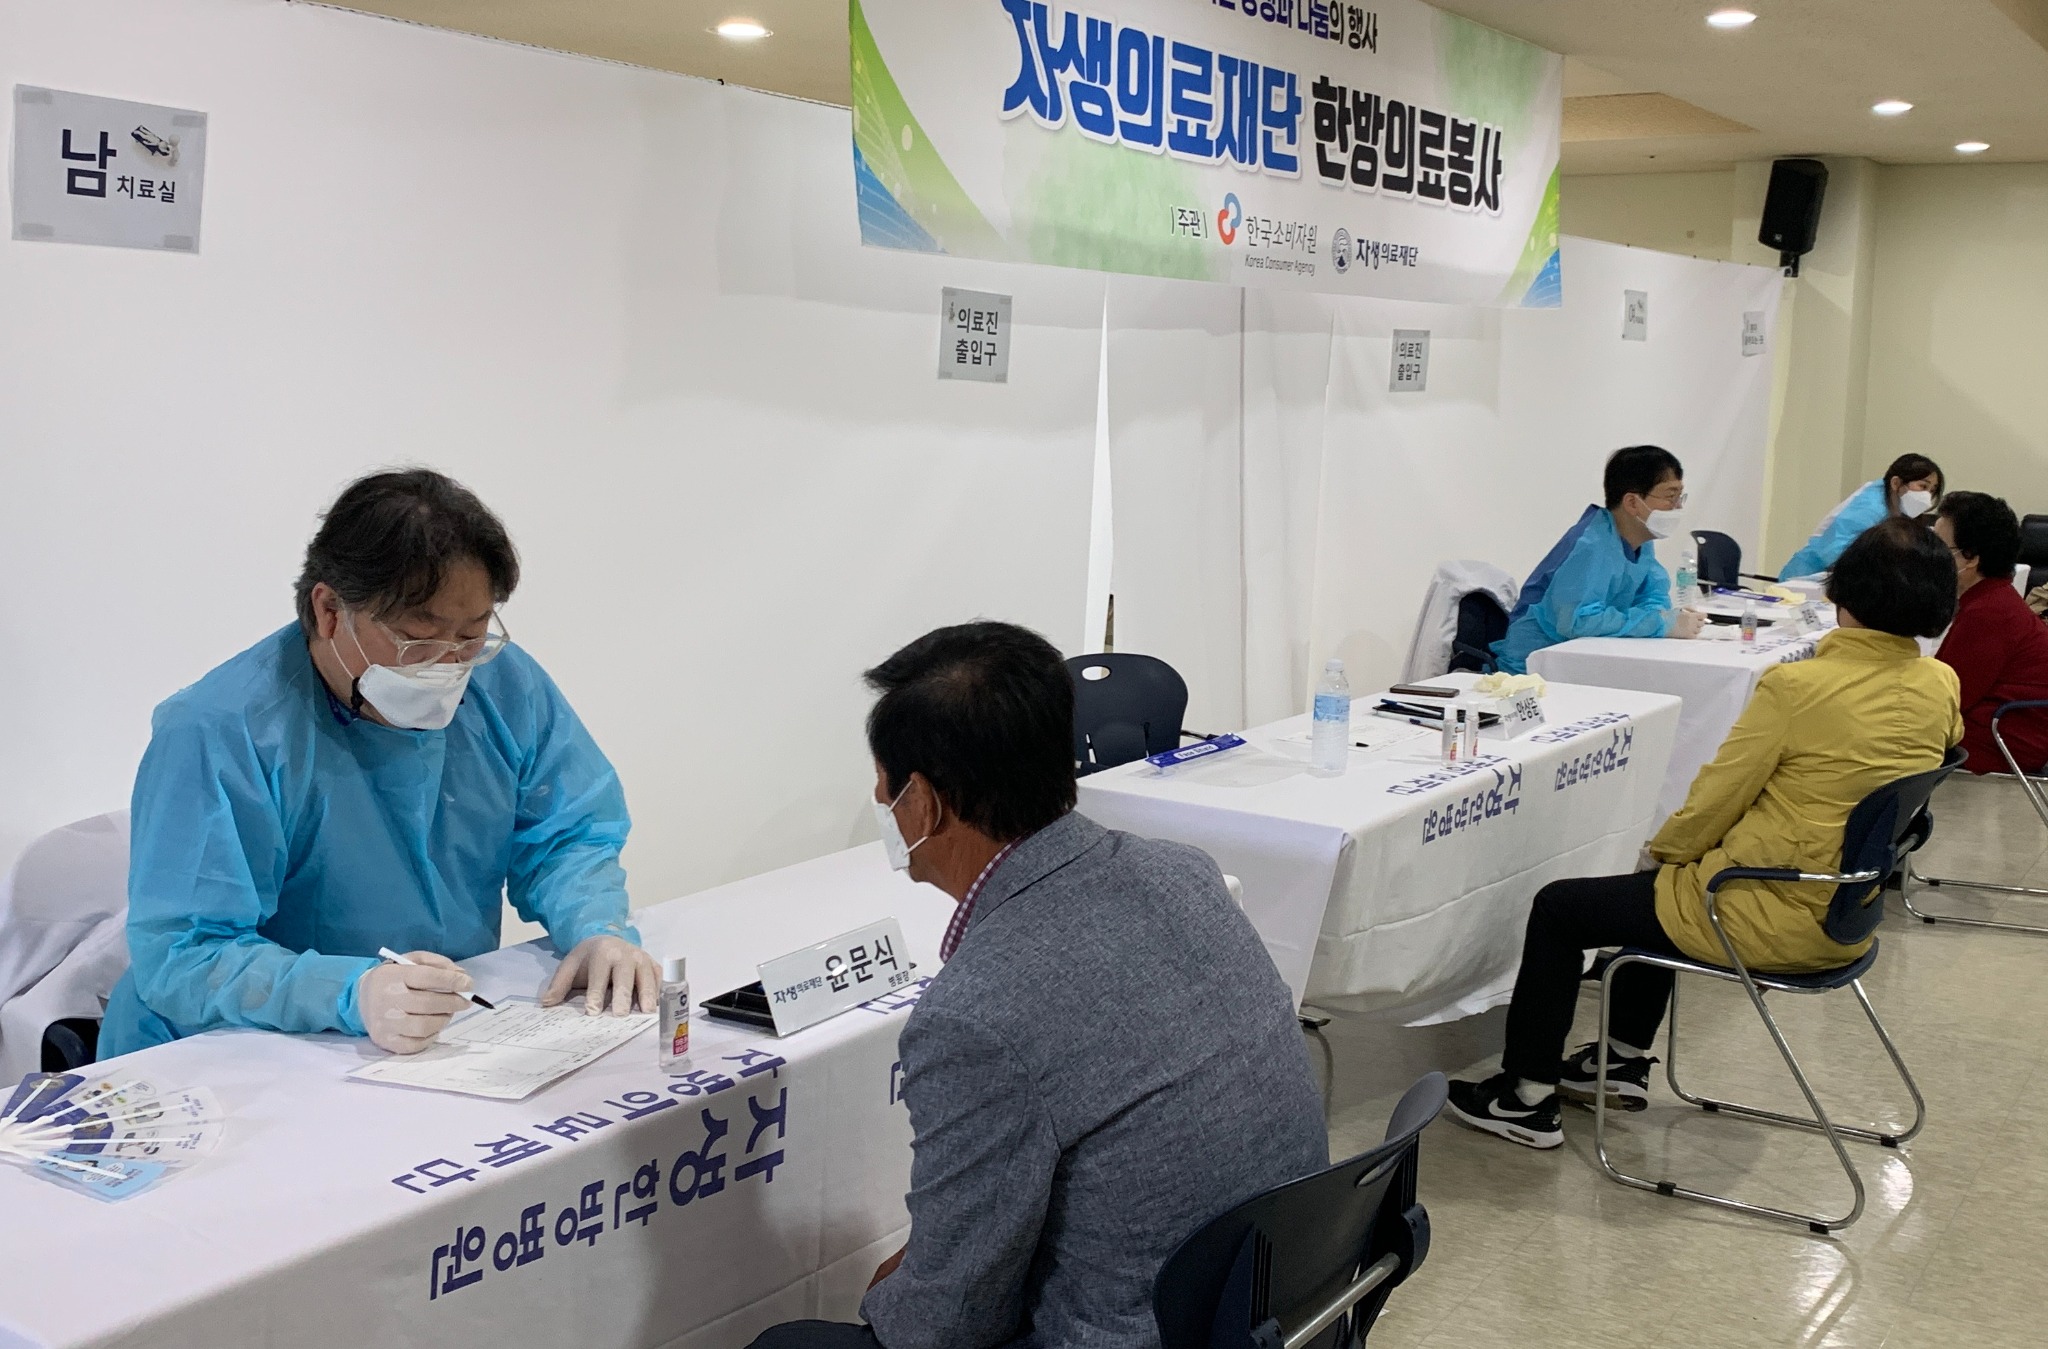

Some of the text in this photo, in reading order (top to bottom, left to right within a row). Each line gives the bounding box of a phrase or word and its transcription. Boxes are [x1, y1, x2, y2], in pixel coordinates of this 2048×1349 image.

[1348, 5, 1377, 53] 행사
[1003, 0, 1502, 211] 자생의료재단 한방의료봉사
[62, 129, 175, 203] 남 치료실
[1245, 216, 1318, 254] 한국소비자원
[1356, 238, 1419, 270] 자생의료재단
[1244, 254, 1316, 276] Korea Consumer Agency
[956, 308, 998, 336] 의료진
[956, 338, 997, 366] 출입구
[1399, 341, 1423, 360] 의료진
[1398, 363, 1421, 381] 출입구
[773, 976, 823, 1005] 자생의료재단
[825, 935, 898, 993] 윤문식
[391, 1048, 787, 1194] 자생의료재단
[430, 1086, 788, 1301] 자생한방병원
